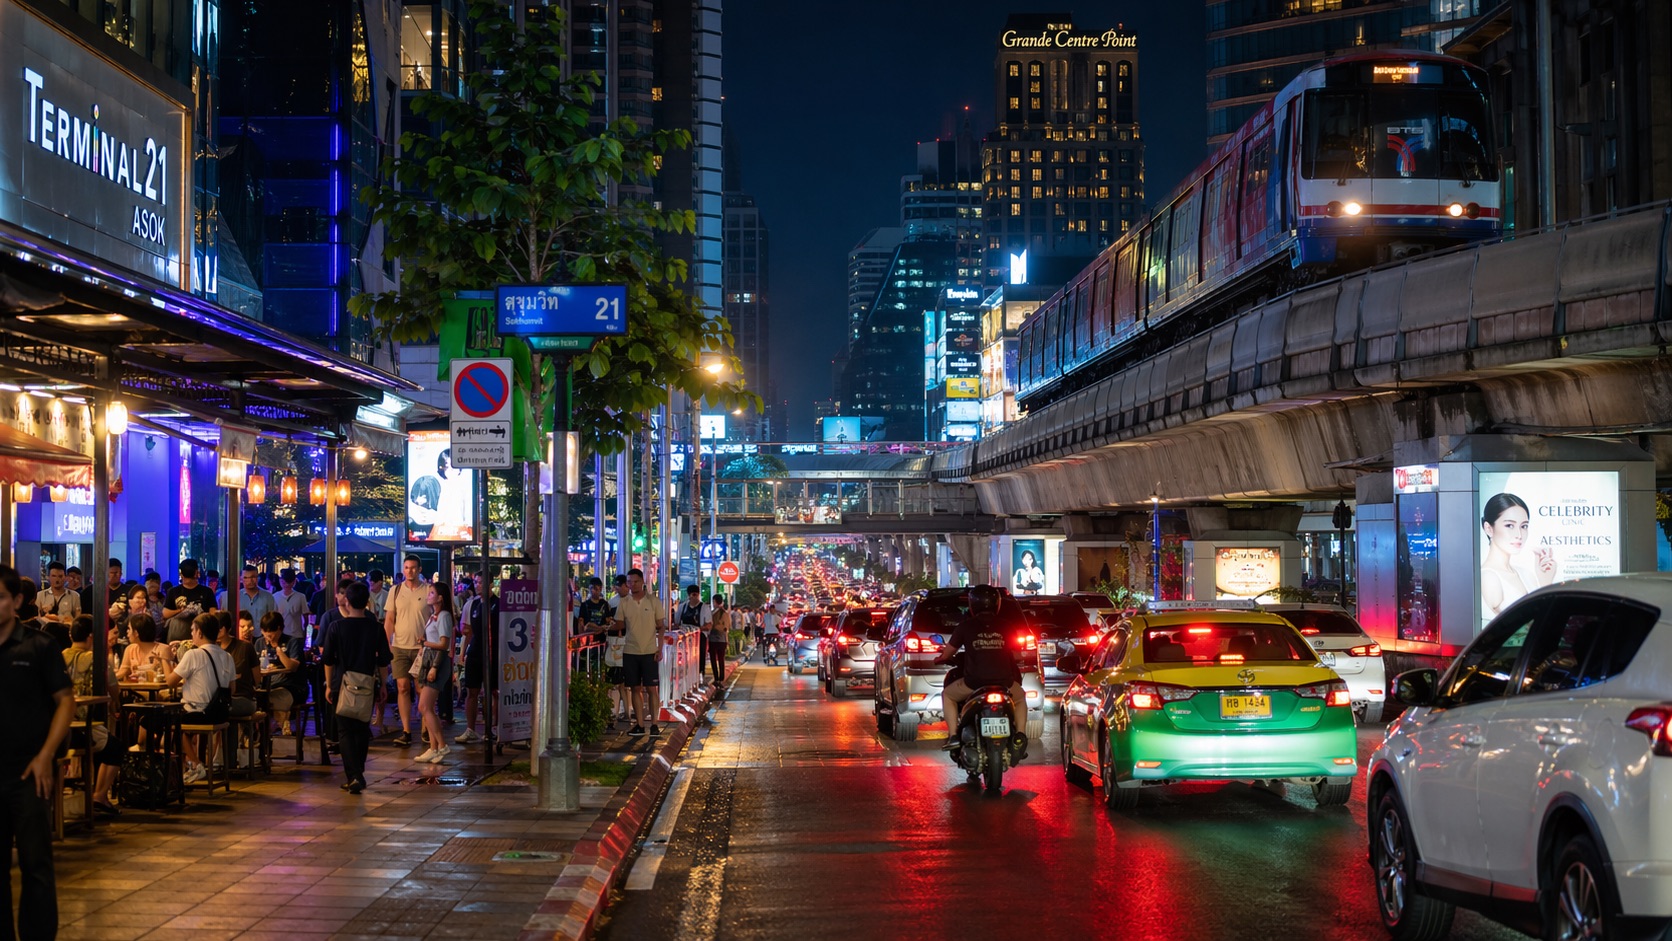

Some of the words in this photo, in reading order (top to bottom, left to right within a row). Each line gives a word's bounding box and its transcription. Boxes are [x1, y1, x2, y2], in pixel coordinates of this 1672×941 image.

[1002, 30, 1052, 47] Grande
[1055, 30, 1099, 47] Centre
[1101, 28, 1137, 47] Point
[132, 205, 165, 246] ASOK
[595, 297, 619, 320] 21
[1538, 505, 1613, 516] CELEBRITY
[1540, 535, 1612, 545] AESTHETICS
[507, 618, 528, 652] 3
